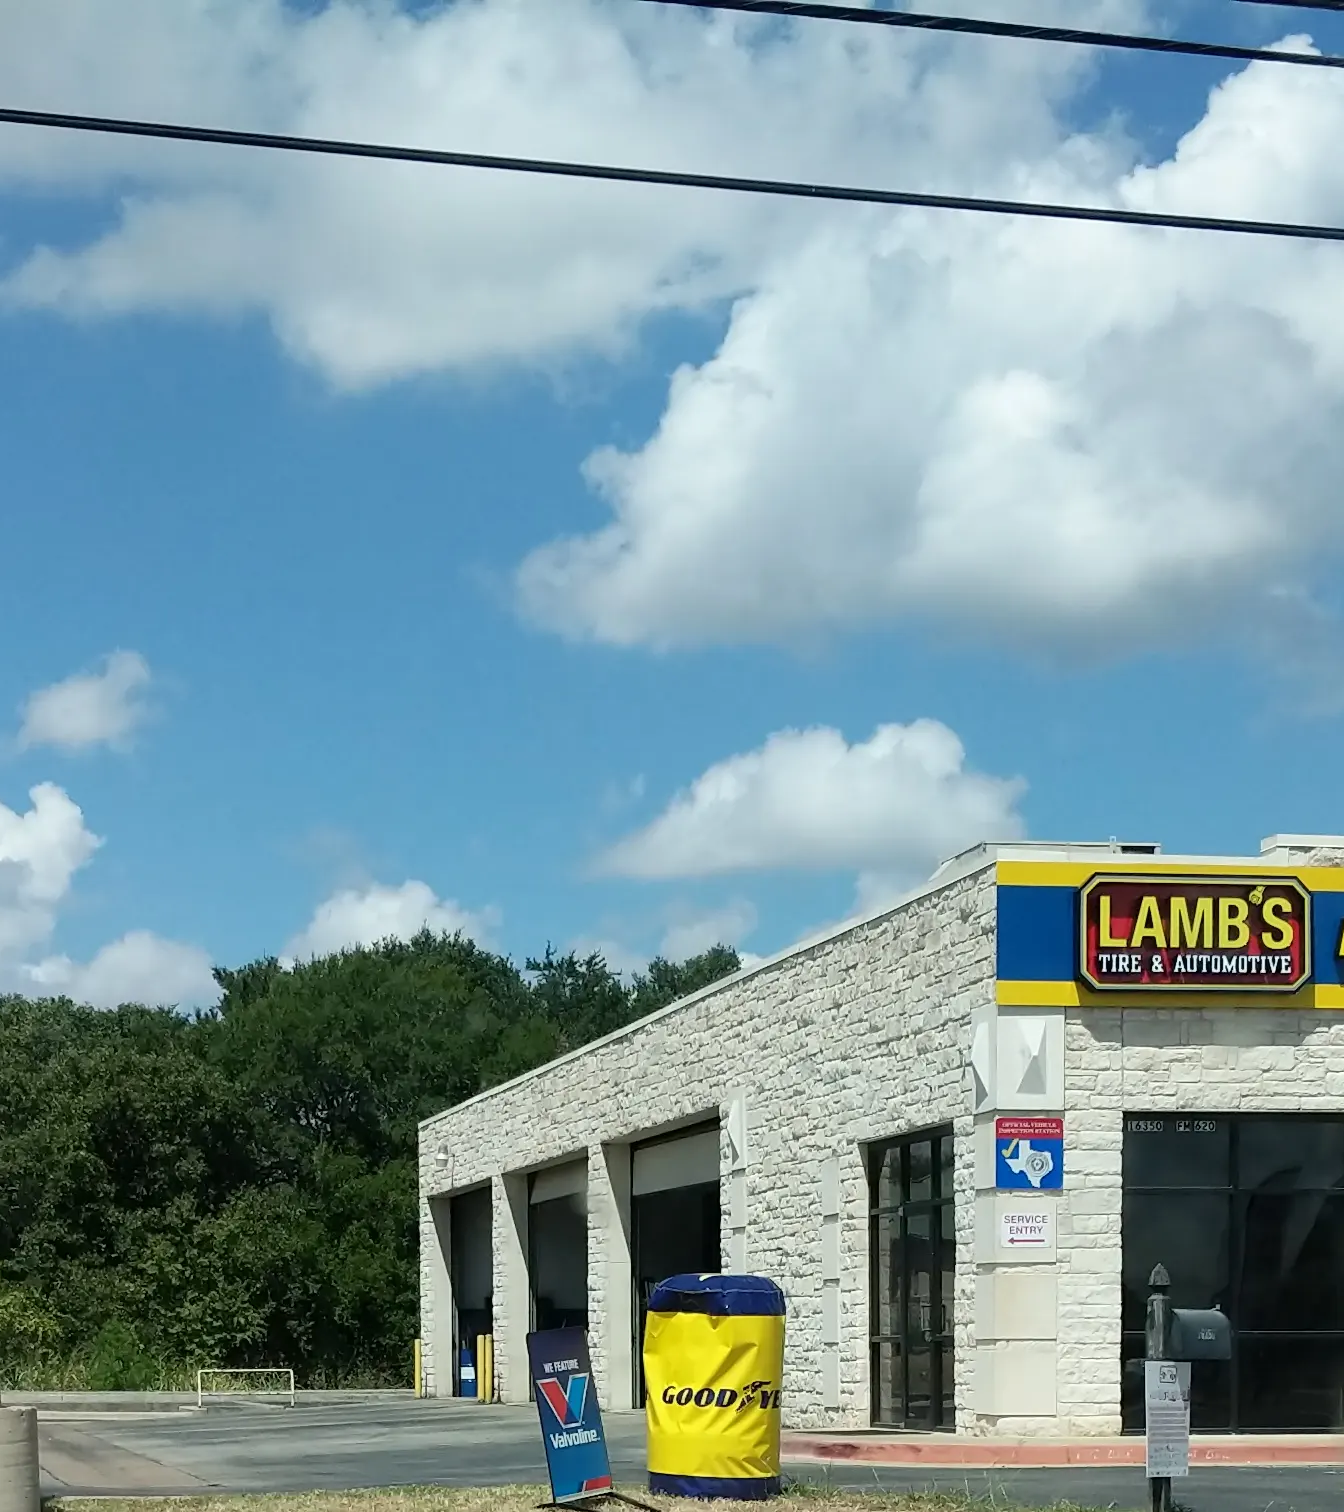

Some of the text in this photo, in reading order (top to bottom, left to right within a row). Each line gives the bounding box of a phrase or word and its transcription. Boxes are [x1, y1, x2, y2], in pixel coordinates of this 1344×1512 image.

[1099, 887, 1294, 950] LAMB'S
[1099, 954, 1292, 974] TIRE & AUTOMOTIVE
[1129, 1121, 1163, 1131] 16350
[1194, 1121, 1215, 1131] 620
[1004, 1215, 1048, 1224] SERVICE
[1009, 1226, 1044, 1235] ENTRY
[543, 1358, 579, 1374] WE FEATURE
[550, 1428, 599, 1449] Valvoline
